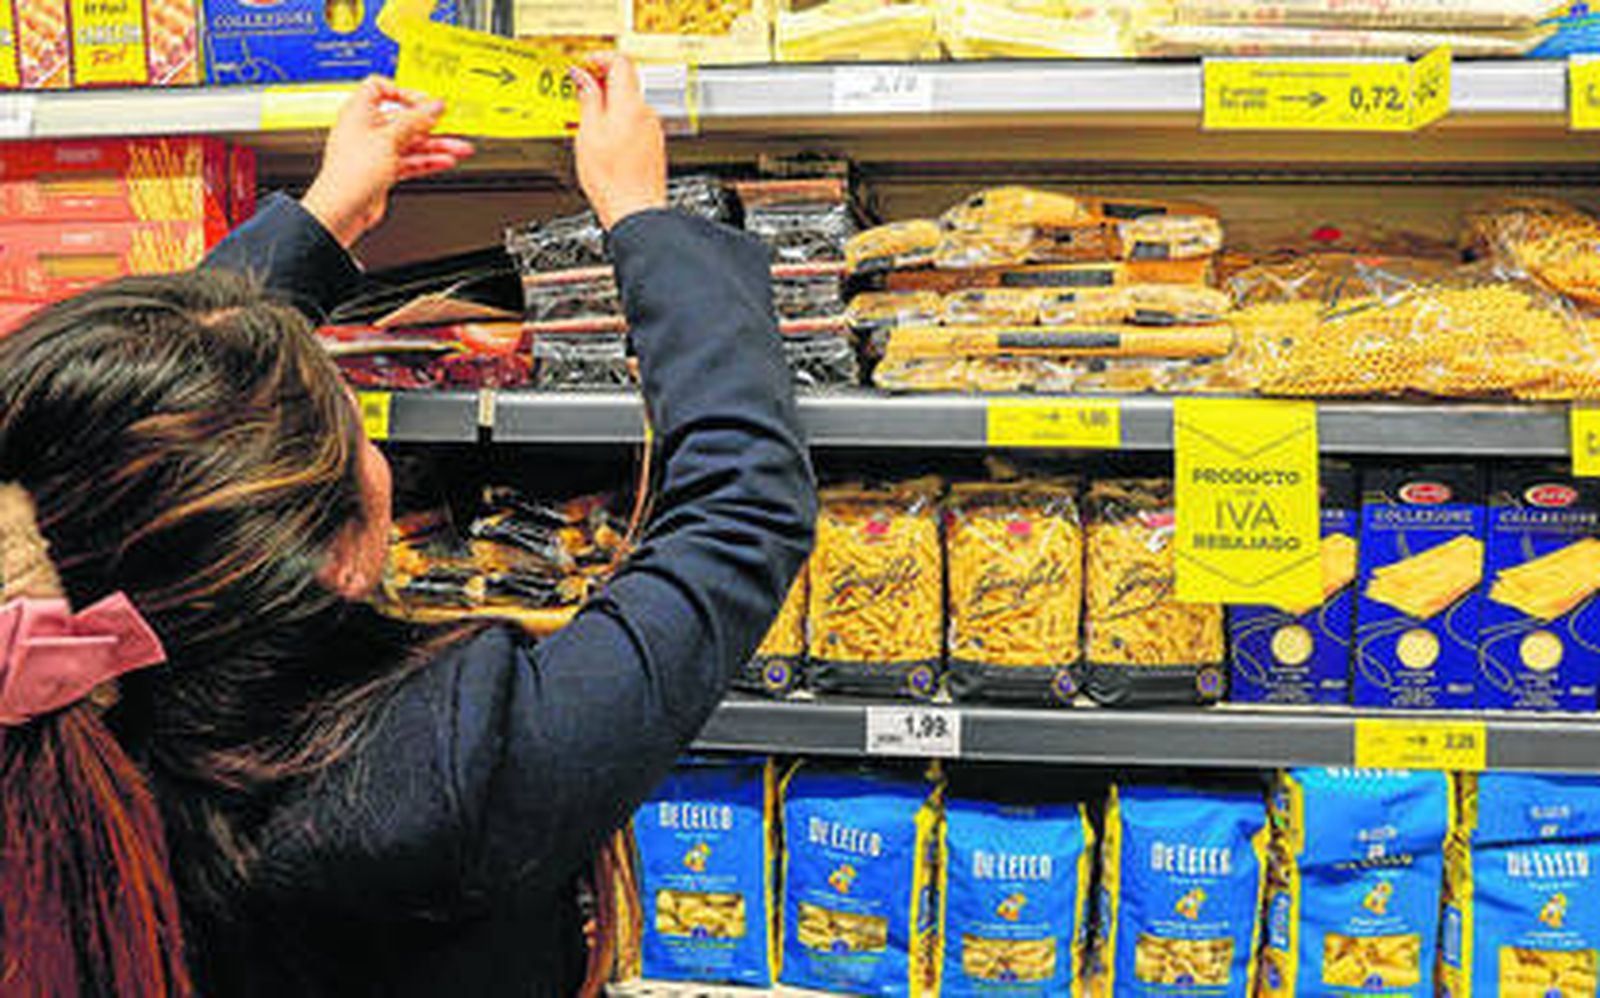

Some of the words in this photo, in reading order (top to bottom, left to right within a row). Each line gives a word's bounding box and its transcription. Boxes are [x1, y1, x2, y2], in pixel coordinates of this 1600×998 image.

[1193, 468, 1300, 485] PRODUCTO
[1216, 501, 1280, 530] IVA
[1193, 533, 1300, 550] REBAJADO
